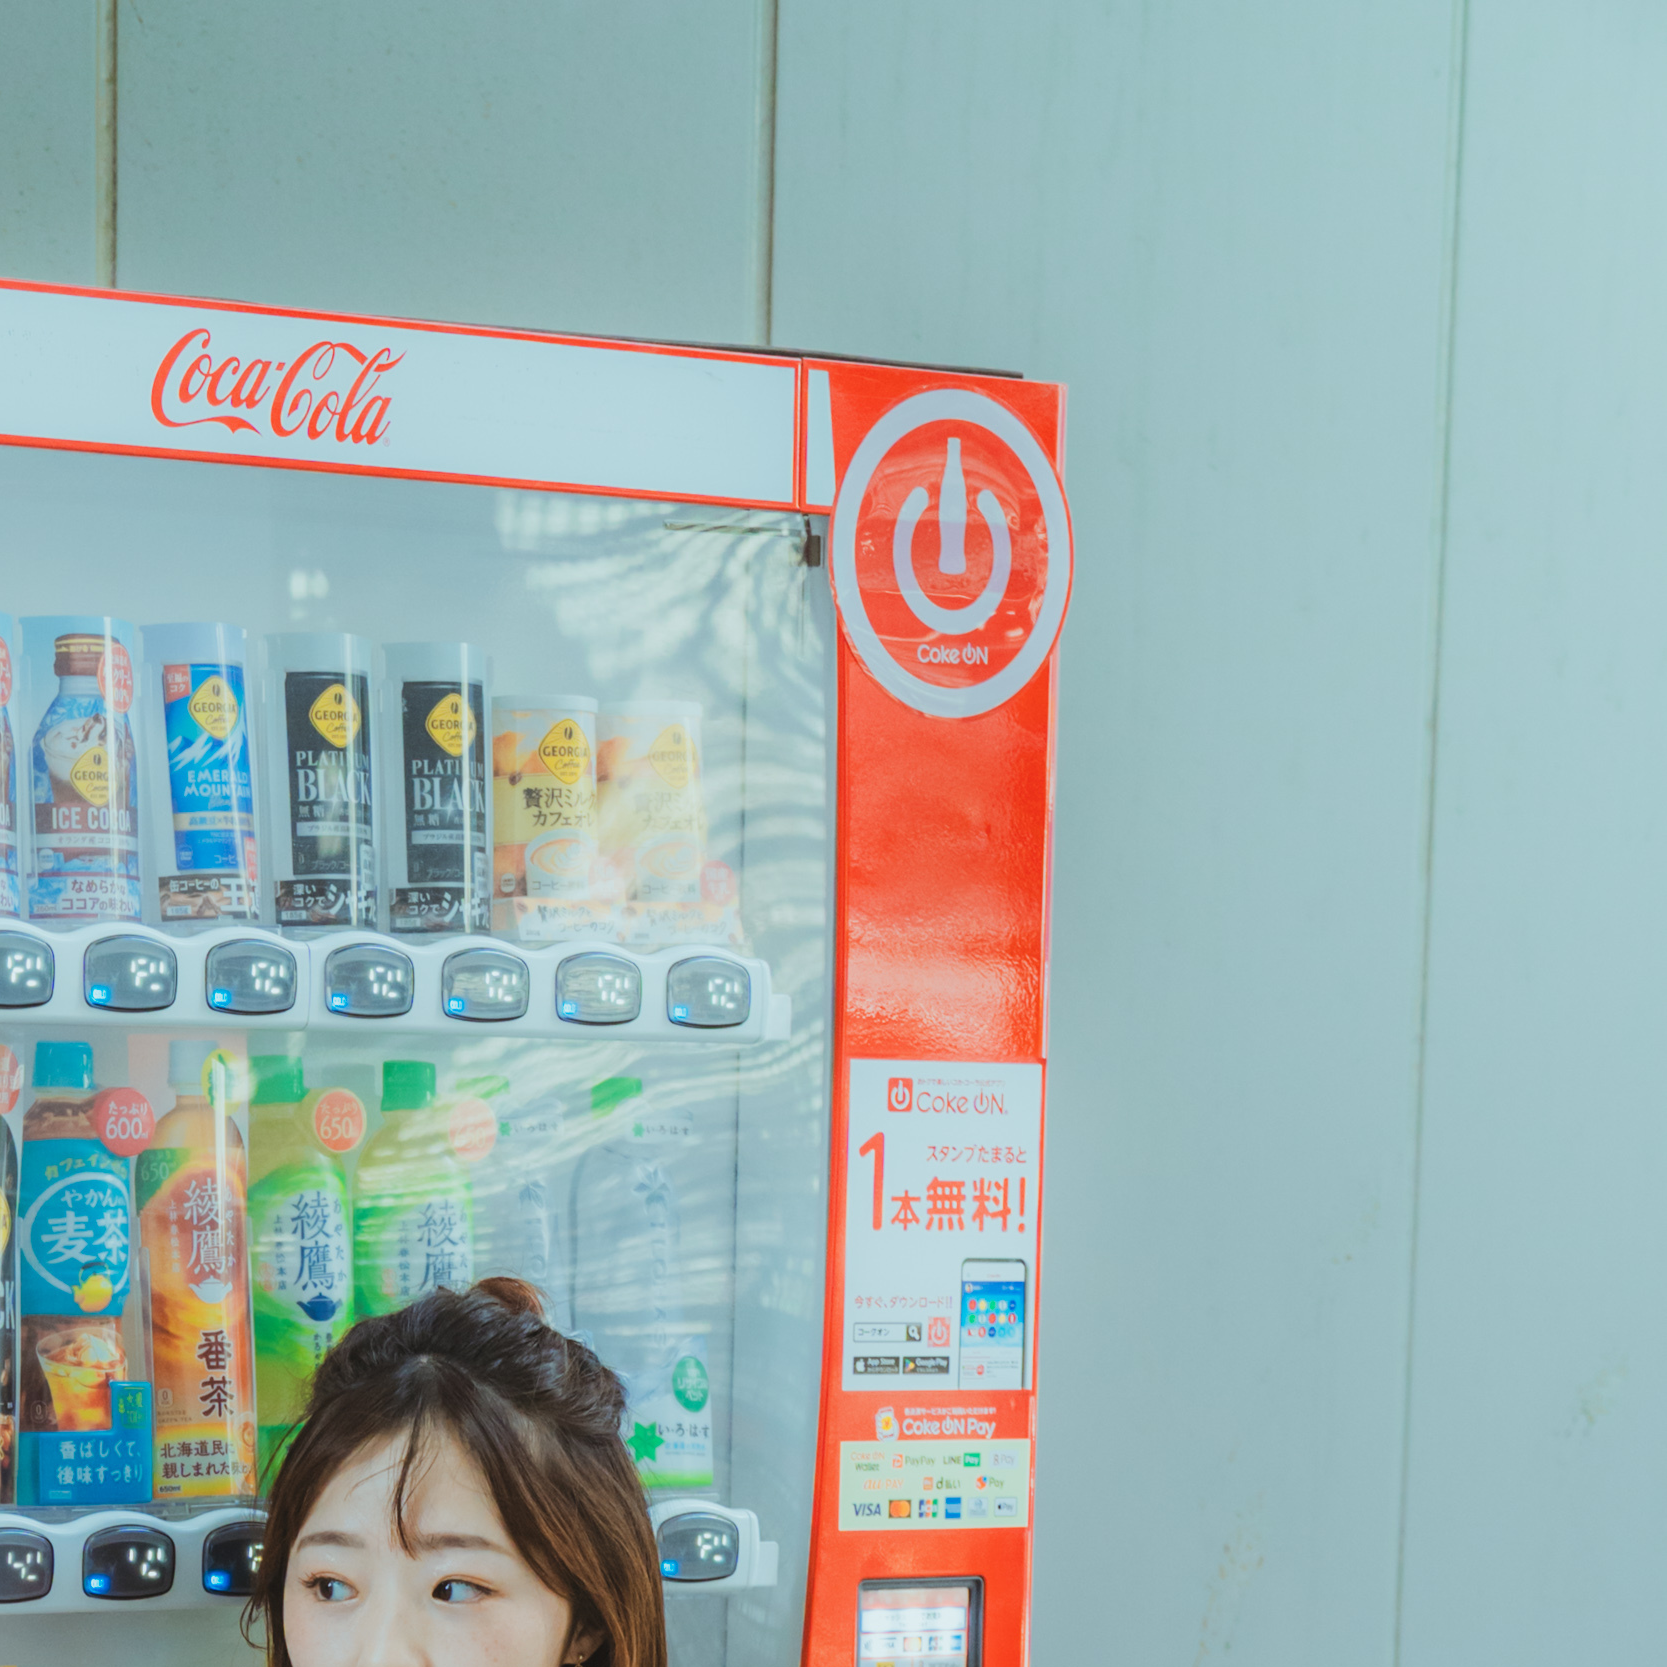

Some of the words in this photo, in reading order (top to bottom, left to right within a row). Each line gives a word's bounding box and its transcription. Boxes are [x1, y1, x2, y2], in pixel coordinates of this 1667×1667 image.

[151, 328, 407, 446] Coca-Cola
[917, 643, 960, 664] Coke
[963, 642, 989, 665] ON
[542, 745, 588, 758] GEORGIA
[187, 769, 248, 784] EMERALD
[411, 758, 483, 779] PLATIUM
[184, 783, 251, 798] MOUNTAIN
[297, 769, 371, 806] BLACK
[412, 777, 484, 814] BLACK
[523, 787, 596, 810] 贅沢ミルク
[52, 807, 81, 829] ICE
[87, 807, 131, 832] COCOA
[532, 810, 595, 828] カフェオレ
[71, 879, 126, 896] なめらかな
[170, 879, 219, 892] 缶コーヒーの
[293, 883, 316, 895] 深い
[62, 897, 134, 912] ココアの味わい
[294, 896, 326, 908] コクで
[408, 891, 431, 903] 深い
[409, 904, 441, 916] コクで
[108, 1101, 148, 1116] たっぷり
[917, 1092, 968, 1113] Coke
[974, 1089, 1004, 1114] ON
[106, 1117, 149, 1140] 600ml
[927, 1145, 1027, 1164] スタンプたまると
[184, 1178, 227, 1275] 綾鷹
[41, 1209, 129, 1265] 麦茶
[290, 1191, 335, 1291] 綾鷹
[858, 1328, 890, 1337] コークオン
[198, 1329, 234, 1417] 番茶
[902, 1418, 940, 1435] Coke
[942, 1416, 965, 1435] ON
[967, 1418, 996, 1439] Pay
[160, 1440, 235, 1459] 北海道民に
[855, 1462, 880, 1472] Wallet
[905, 1456, 935, 1467] PayPay
[943, 1456, 961, 1465] LINE
[965, 1455, 979, 1466] Pay
[56, 1464, 143, 1486] 後味すっきり
[989, 1477, 1005, 1490] Pay
[864, 1478, 882, 1490] au
[885, 1479, 904, 1490] PAY
[853, 1503, 882, 1517] VISA
